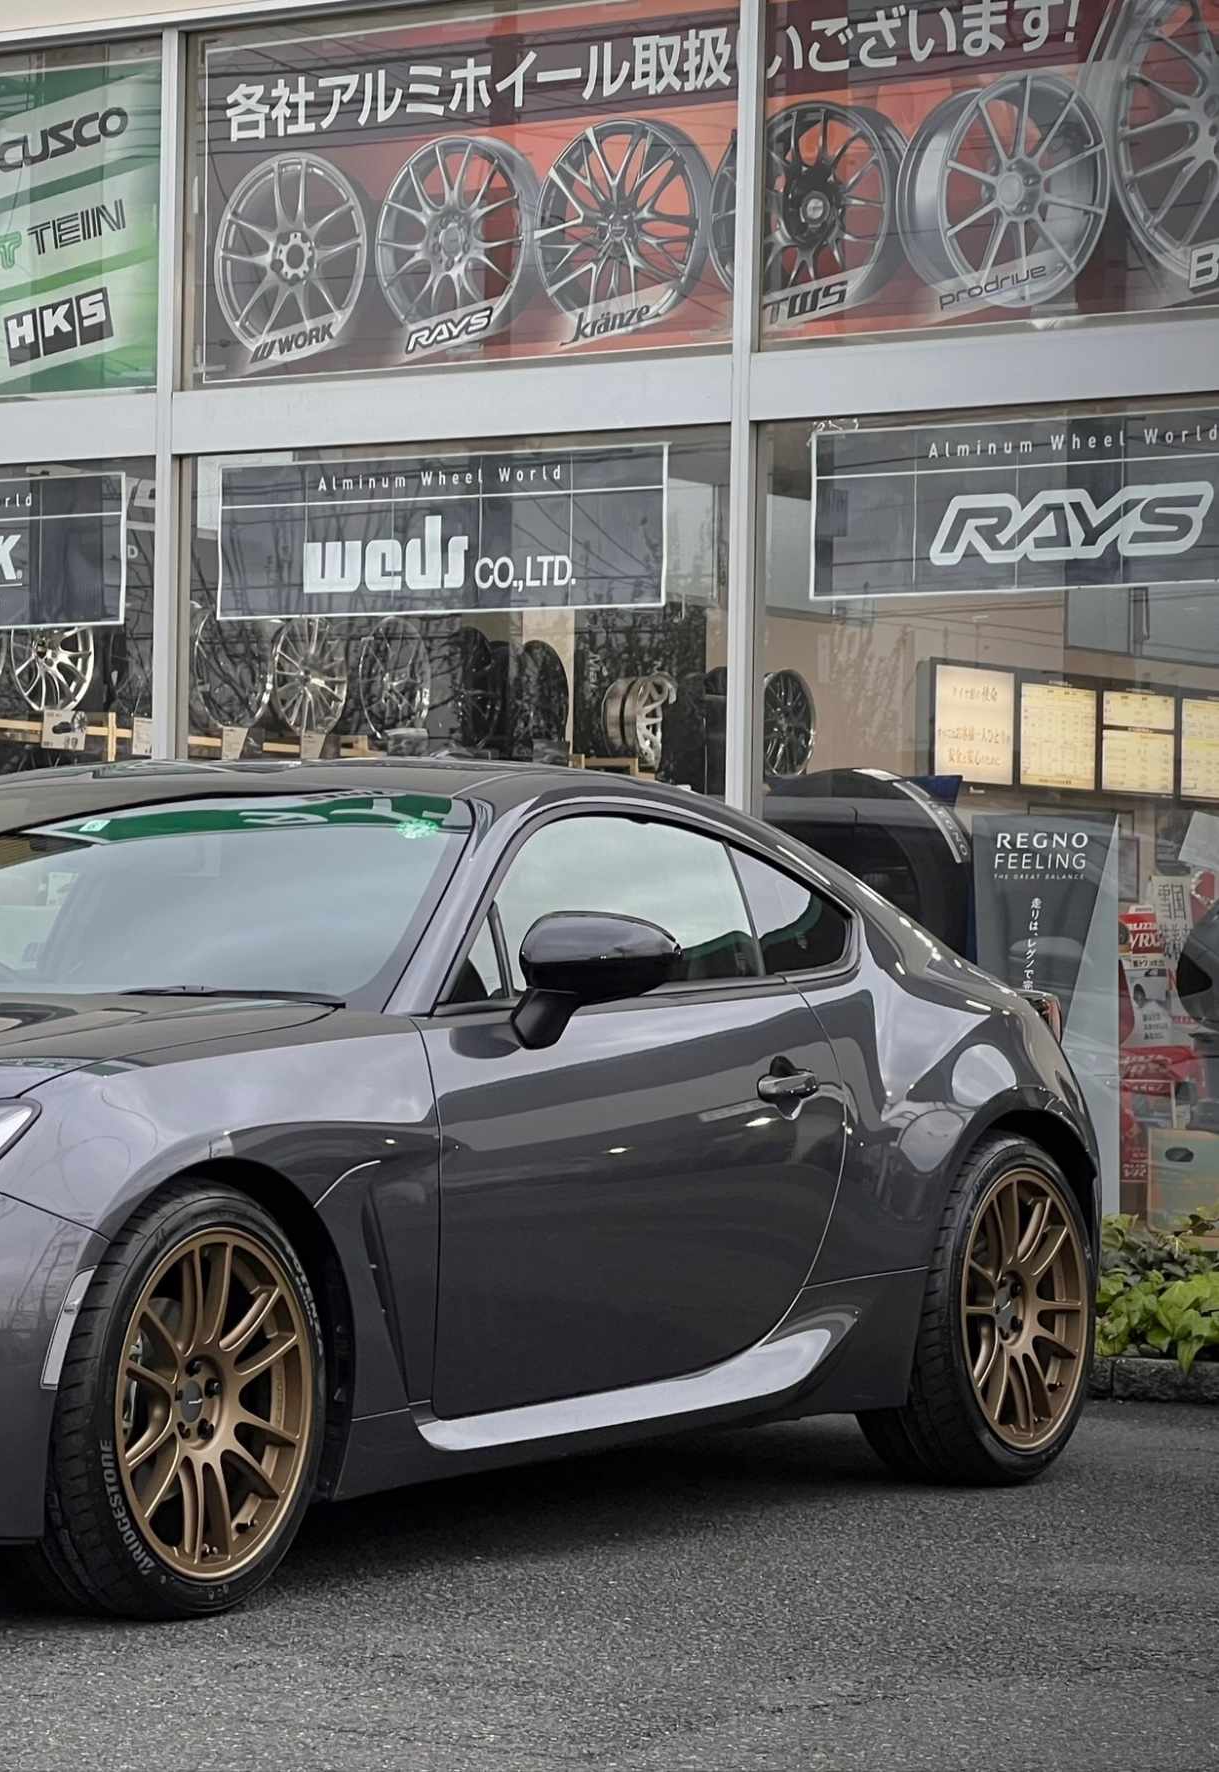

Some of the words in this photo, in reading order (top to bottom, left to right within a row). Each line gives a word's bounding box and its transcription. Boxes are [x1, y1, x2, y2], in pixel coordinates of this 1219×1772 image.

[27, 199, 126, 256] TEIN
[938, 264, 1047, 311] prodrive
[6, 291, 110, 353] HKS
[277, 321, 334, 356] WORK
[406, 306, 494, 354] RAYS
[929, 439, 1033, 459] Alminum
[1050, 431, 1126, 451] Wheel
[1144, 424, 1219, 445] World
[318, 474, 406, 491] Alminum
[420, 468, 483, 487] Wheel
[499, 464, 562, 482] World
[929, 480, 1214, 566] RAYS
[303, 514, 469, 593] weds
[994, 853, 1086, 870] FEELING
[996, 832, 1089, 849] REGNO
[99, 1439, 156, 1575] BRIDGESTONE
